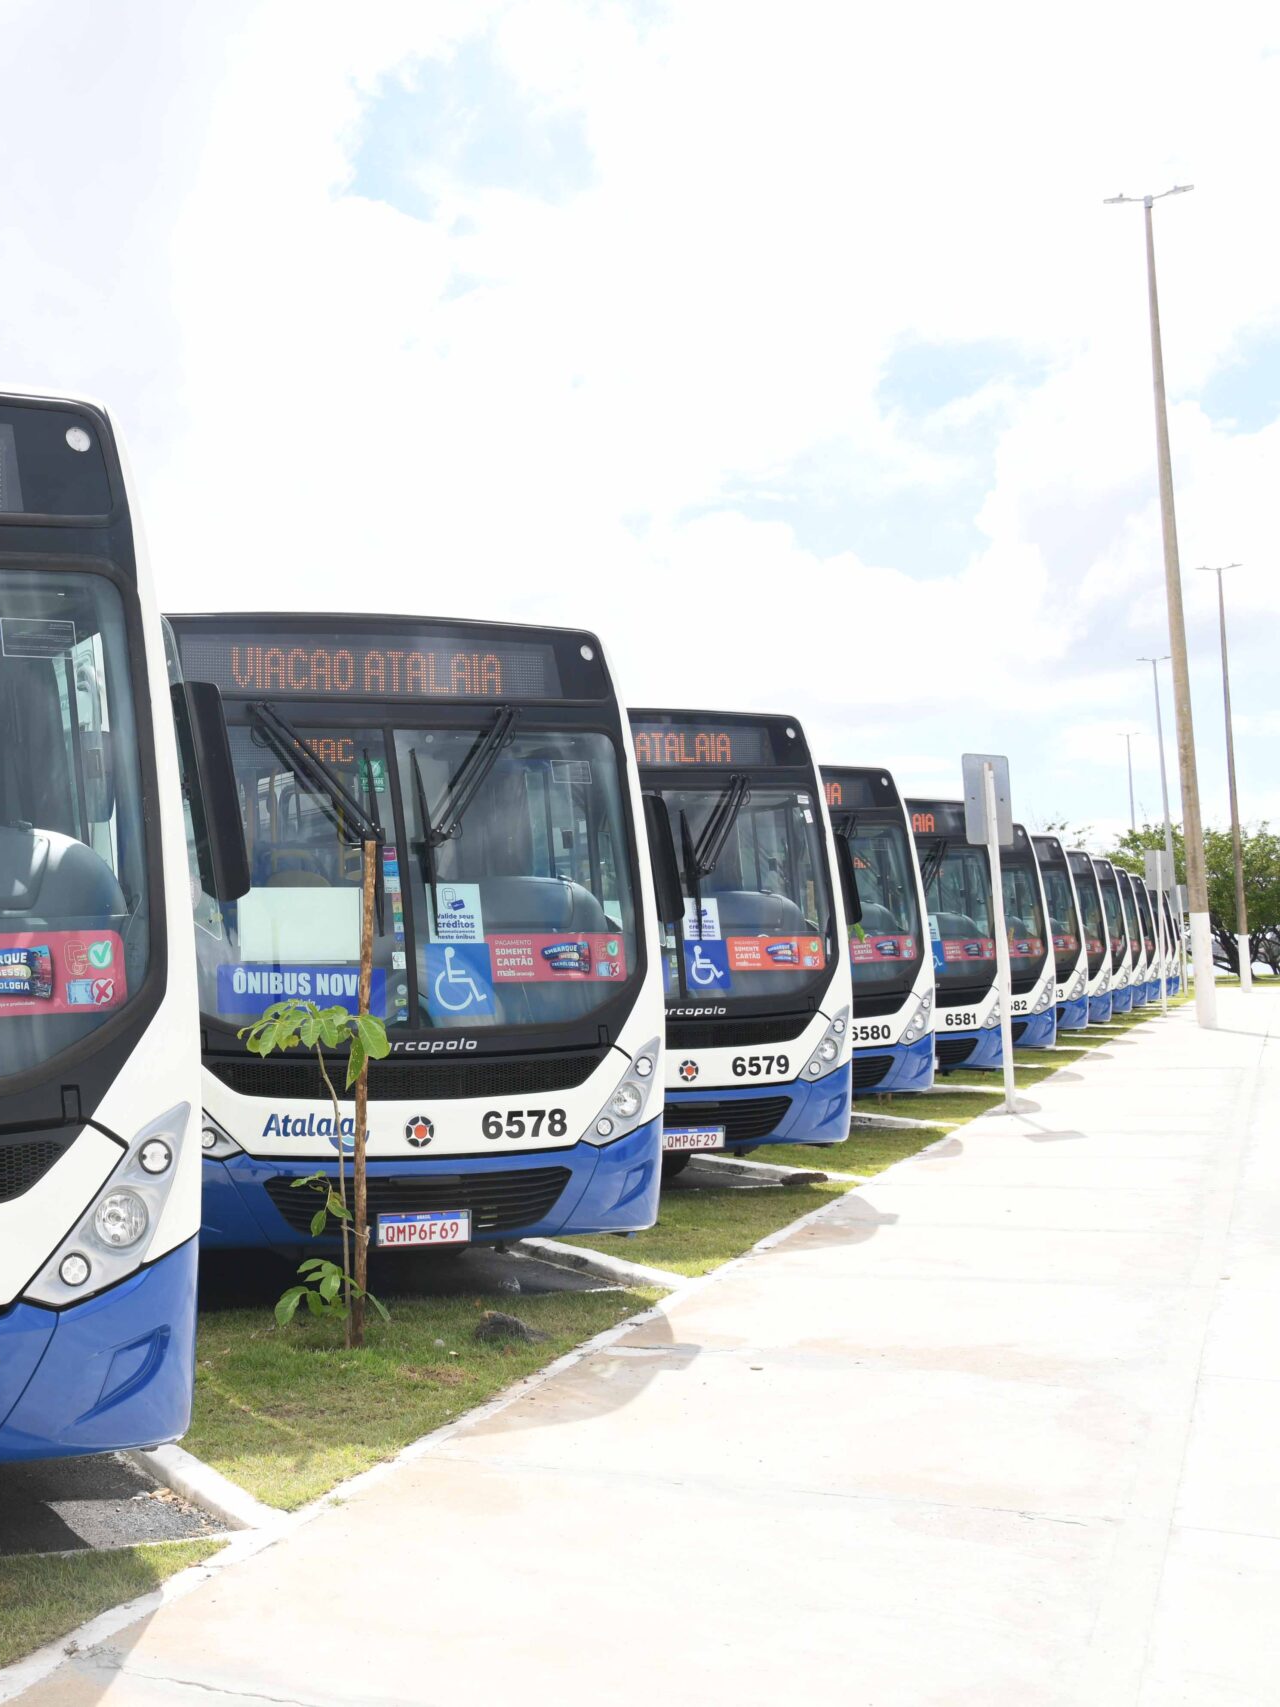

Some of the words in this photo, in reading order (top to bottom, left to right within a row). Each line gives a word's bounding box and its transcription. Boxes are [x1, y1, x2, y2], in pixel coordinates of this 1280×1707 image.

[231, 646, 355, 692] VIACAO
[363, 650, 503, 695] ATALAIA
[634, 732, 732, 763] ATALAIA
[437, 919, 476, 929] créditos
[495, 947, 533, 956] SOMENTE
[544, 944, 578, 955] EMBARQUE
[496, 955, 534, 966] CARTÃO
[496, 969, 516, 977] mais
[232, 967, 312, 996] ÔNIBUS
[316, 972, 361, 997] NOV
[945, 1012, 977, 1026] 6581
[388, 1037, 478, 1054] rcopolo
[731, 1054, 790, 1077] 6579
[481, 1108, 568, 1140] 6578
[667, 1133, 718, 1148] QMP6F29
[385, 1221, 459, 1243] QMP6F69
